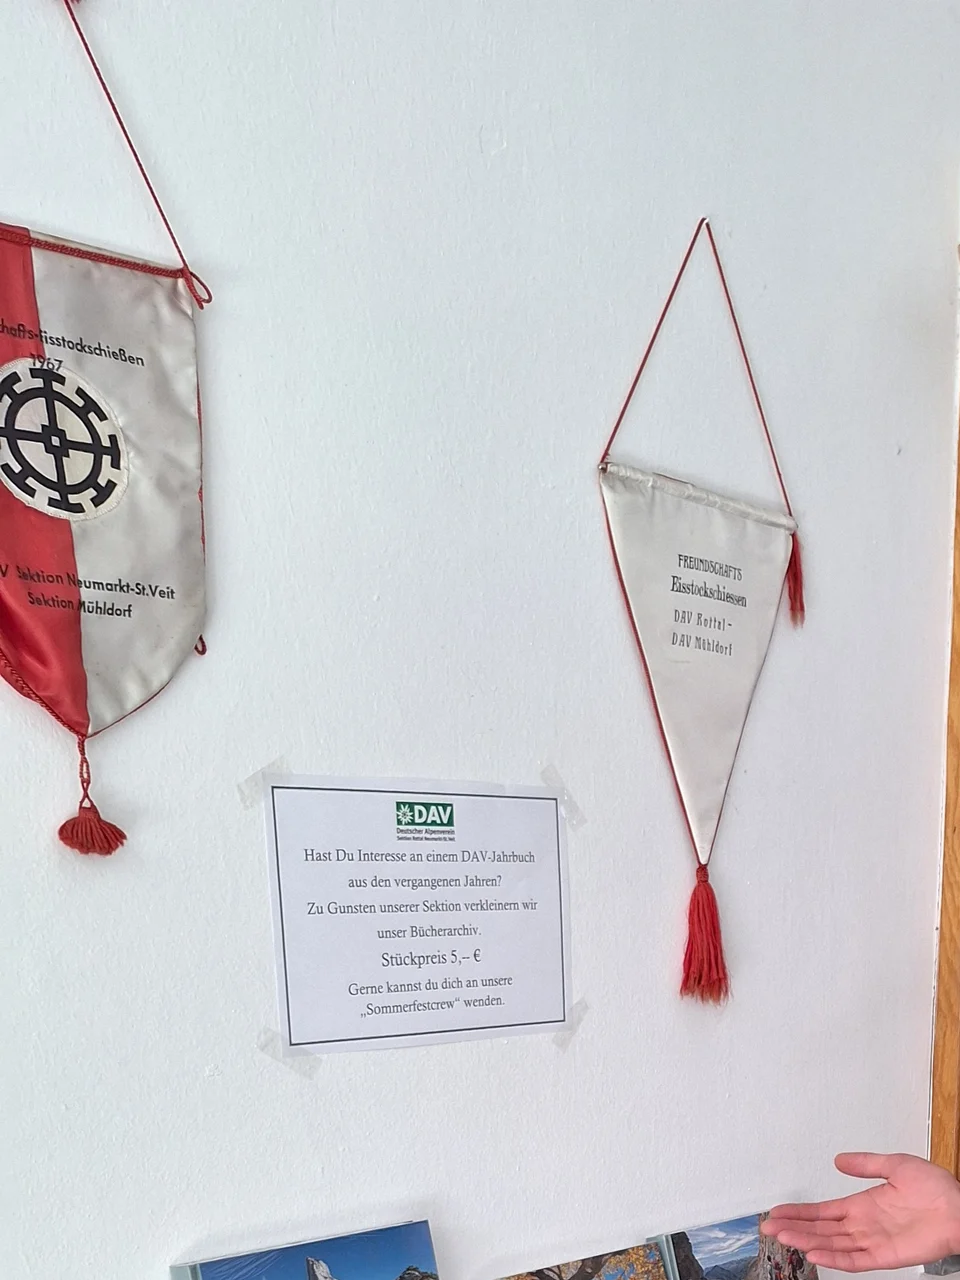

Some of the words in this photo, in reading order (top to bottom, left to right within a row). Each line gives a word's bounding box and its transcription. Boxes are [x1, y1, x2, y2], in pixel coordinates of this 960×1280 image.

[30, 353, 63, 371] 1967
[17, 565, 64, 584] Sektion
[678, 554, 742, 581] FREUNDSCHAFTS
[670, 575, 746, 607] Eisstockschiessen
[28, 592, 74, 610] Sektion
[674, 609, 692, 624] DAV
[672, 632, 691, 648] DAV
[414, 805, 452, 824] DAV
[304, 849, 332, 862] Hast
[335, 849, 354, 862] Du
[358, 850, 406, 862] Interesse
[410, 853, 423, 862] an
[426, 851, 458, 862] einem
[461, 850, 535, 863] DAV-Jahrbuch
[348, 878, 367, 888] aus
[371, 875, 391, 888] den
[394, 877, 461, 890] vergangenen
[463, 875, 502, 887] Jahren?
[307, 902, 324, 915] Zu
[327, 901, 376, 914] Gunsten
[379, 903, 420, 913] unserer
[423, 900, 462, 912] Sektion
[464, 900, 520, 912] verkleinern
[522, 899, 538, 910] wir
[377, 929, 407, 939] unser
[410, 924, 482, 938] Bücherarchiv.
[382, 950, 447, 968] Stückpreis
[473, 949, 482, 963] €
[348, 983, 383, 996] Gerne
[386, 981, 423, 994] kannst
[426, 979, 438, 991] du
[441, 978, 463, 990] dich
[466, 979, 478, 989] an
[481, 976, 513, 987] unsere
[464, 995, 505, 1008] wenden.
